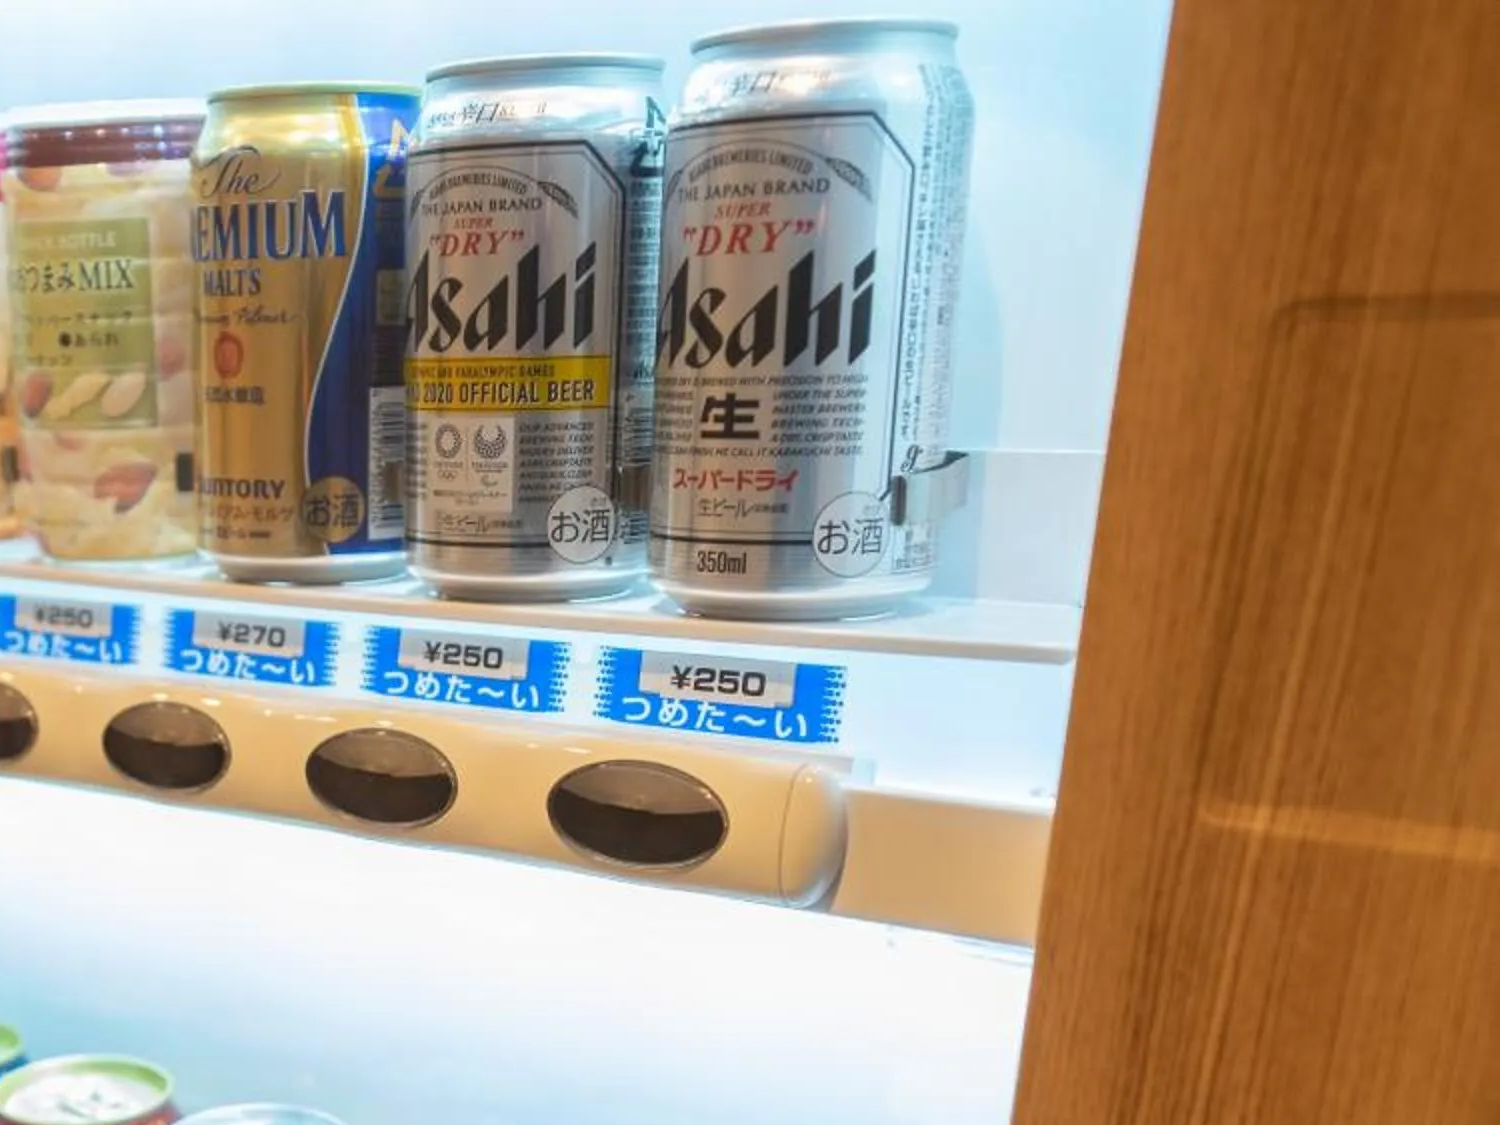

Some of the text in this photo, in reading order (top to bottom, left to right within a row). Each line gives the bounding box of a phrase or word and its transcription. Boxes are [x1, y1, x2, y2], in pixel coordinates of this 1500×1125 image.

[192, 145, 281, 198] The
[704, 183, 756, 200] JAPAN
[763, 178, 832, 194] BRAND
[441, 199, 484, 215] JAPAN
[489, 197, 542, 212] BRAND
[714, 202, 772, 219] SUPER
[405, 240, 597, 353] Asahi
[652, 249, 877, 370] Asahi
[459, 379, 540, 404] OFFICIAL
[546, 378, 595, 403] BEER
[700, 392, 761, 440] 生
[673, 467, 799, 493] スーパードライ
[551, 508, 612, 544] お酒
[816, 518, 885, 556] お酒
[696, 550, 748, 575] 350ml
[31, 601, 95, 630] ¥250
[217, 620, 287, 648] ¥270
[423, 639, 504, 670] ¥250
[670, 664, 768, 698] ¥250
